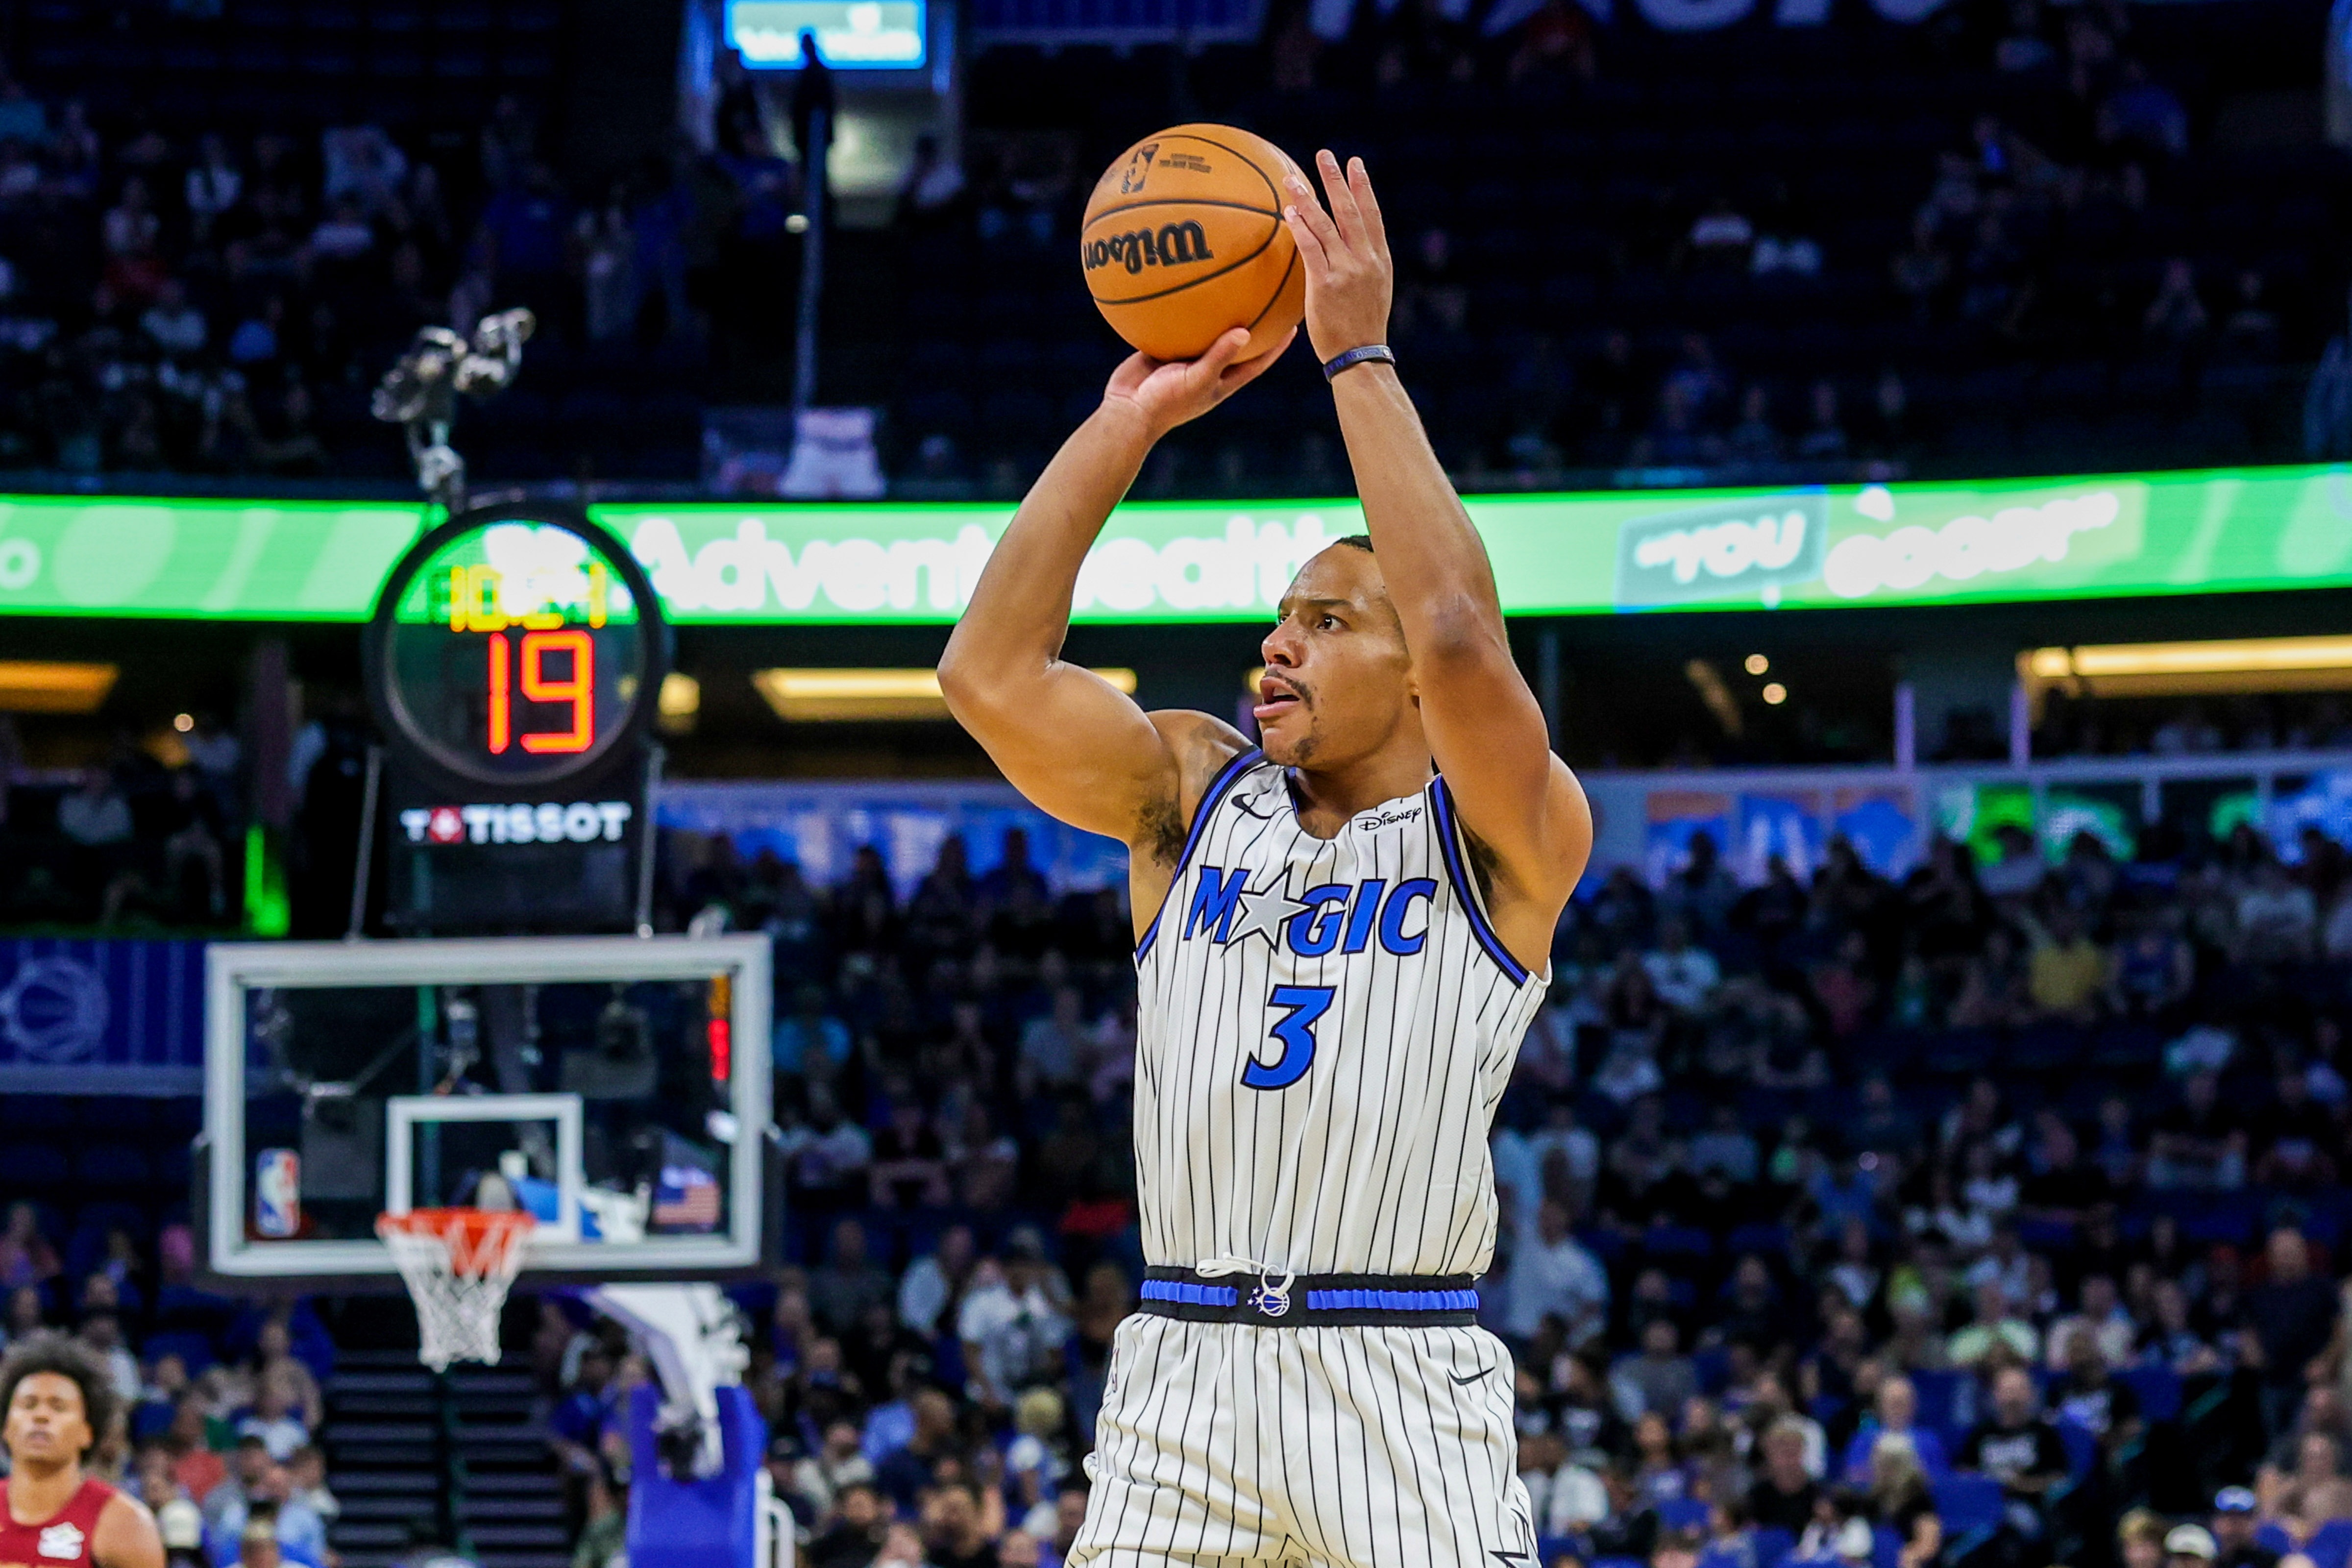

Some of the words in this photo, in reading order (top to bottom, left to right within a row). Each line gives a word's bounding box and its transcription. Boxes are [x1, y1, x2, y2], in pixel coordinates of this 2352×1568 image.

[1083, 220, 1214, 274] Wilson
[632, 518, 1343, 611] Adventealt
[489, 631, 594, 754] 19
[462, 802, 632, 844] TISSOT
[1241, 985, 1338, 1089] 3
